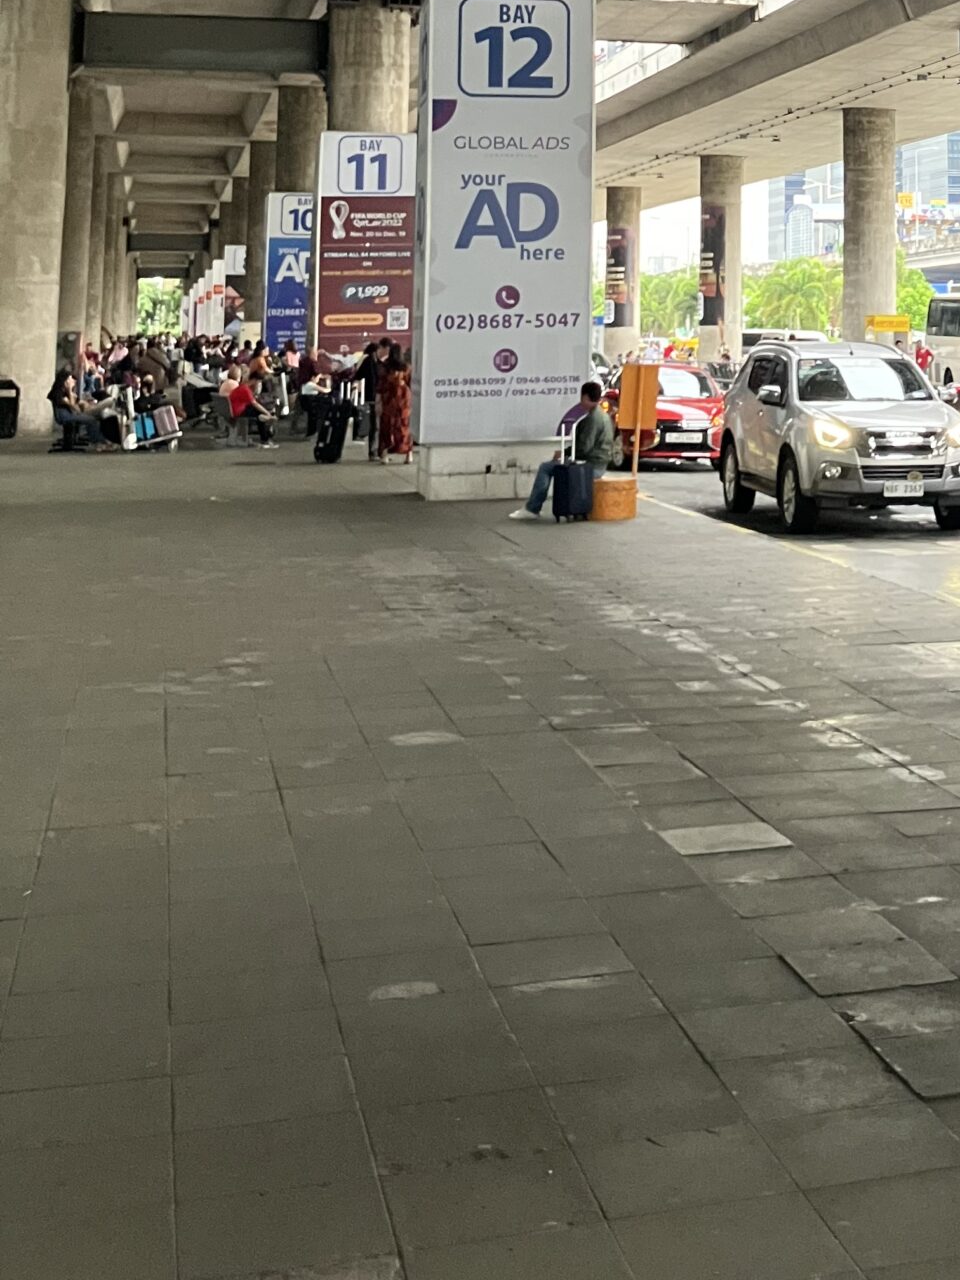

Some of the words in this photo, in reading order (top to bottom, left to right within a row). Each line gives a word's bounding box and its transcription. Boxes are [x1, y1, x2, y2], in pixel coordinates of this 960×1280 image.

[499, 4, 536, 24] BAY
[474, 26, 553, 88] 12
[360, 139, 383, 151] BAY
[453, 135, 528, 150] GLOBAL
[531, 136, 571, 150] ADS
[347, 153, 388, 191] 11
[460, 173, 506, 189] your
[454, 182, 560, 249] AD
[520, 244, 565, 260] here
[435, 312, 581, 333] (02)8687-5047
